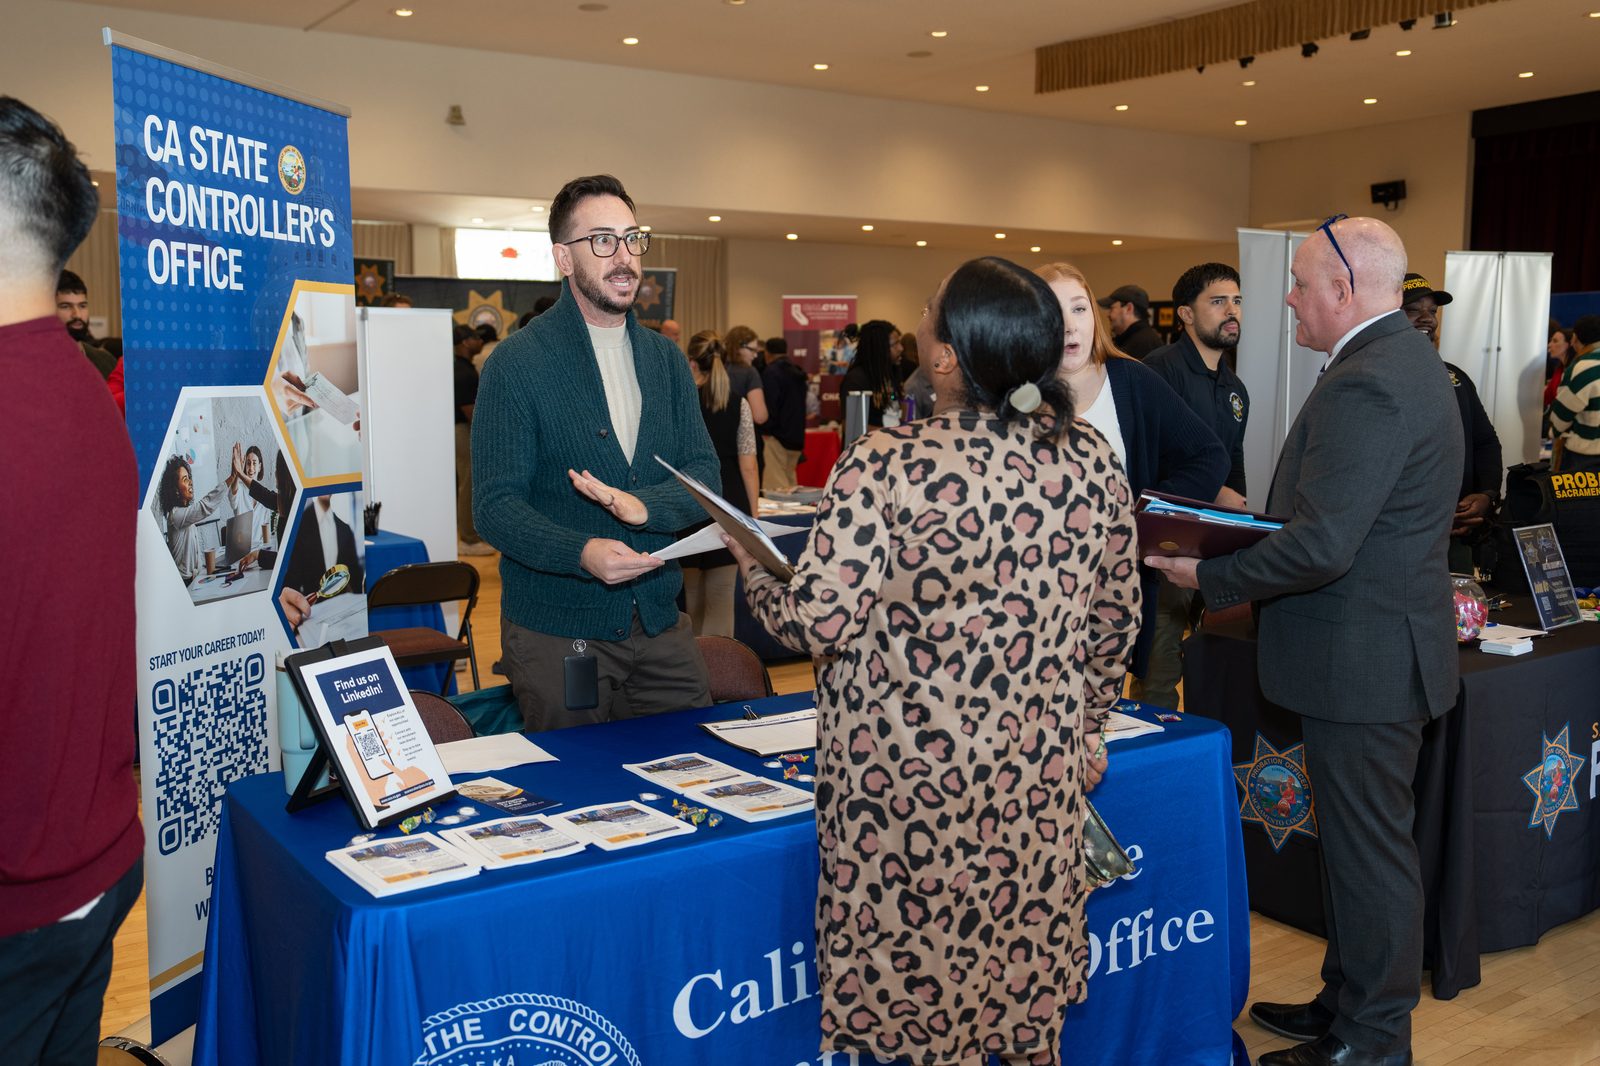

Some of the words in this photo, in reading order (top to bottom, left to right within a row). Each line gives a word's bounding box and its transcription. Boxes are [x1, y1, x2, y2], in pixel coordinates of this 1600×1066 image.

[144, 115, 184, 166] CA
[189, 125, 269, 183] STATE
[146, 177, 335, 248] CONTROLLER'S
[147, 239, 244, 291] OFFICE
[1551, 472, 1600, 491] PROB
[149, 651, 178, 671] START
[178, 644, 203, 662] YOUR
[204, 636, 236, 656] CAREER
[237, 628, 265, 647] TODAY!
[333, 676, 356, 692] Find
[356, 676, 368, 686] us
[367, 673, 380, 683] on
[340, 683, 383, 704] LinkedIn!
[1251, 757, 1283, 779] PROBATION
[1285, 761, 1309, 790] OFFICER
[673, 941, 821, 1039] Cali
[424, 1017, 485, 1056] THE
